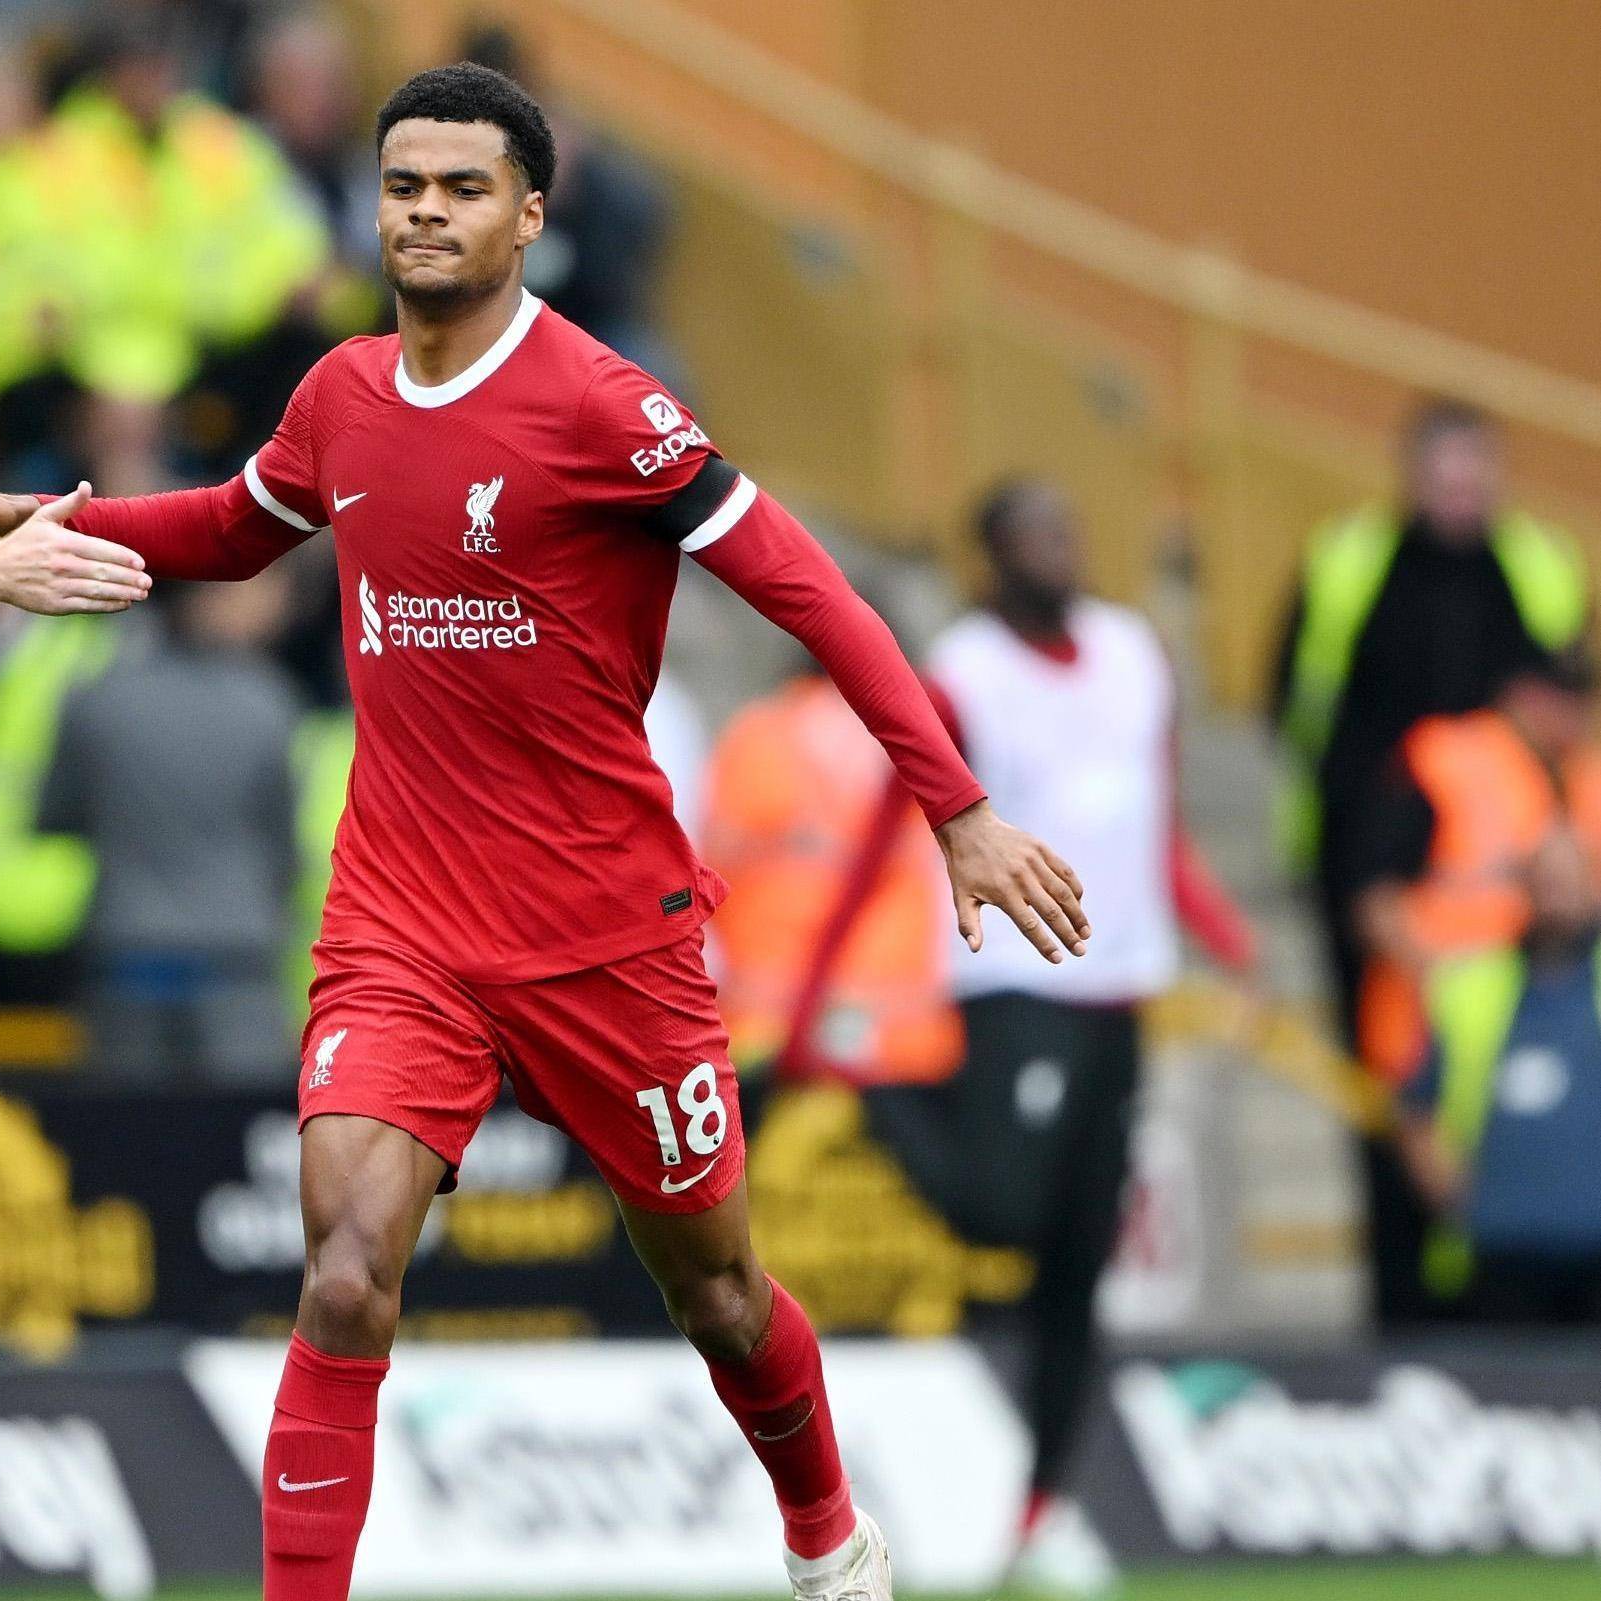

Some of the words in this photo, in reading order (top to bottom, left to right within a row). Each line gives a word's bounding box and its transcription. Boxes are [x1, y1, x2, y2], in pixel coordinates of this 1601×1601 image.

[387, 591, 522, 621] standard
[387, 618, 538, 649] chartered
[636, 1062, 727, 1166] 18
